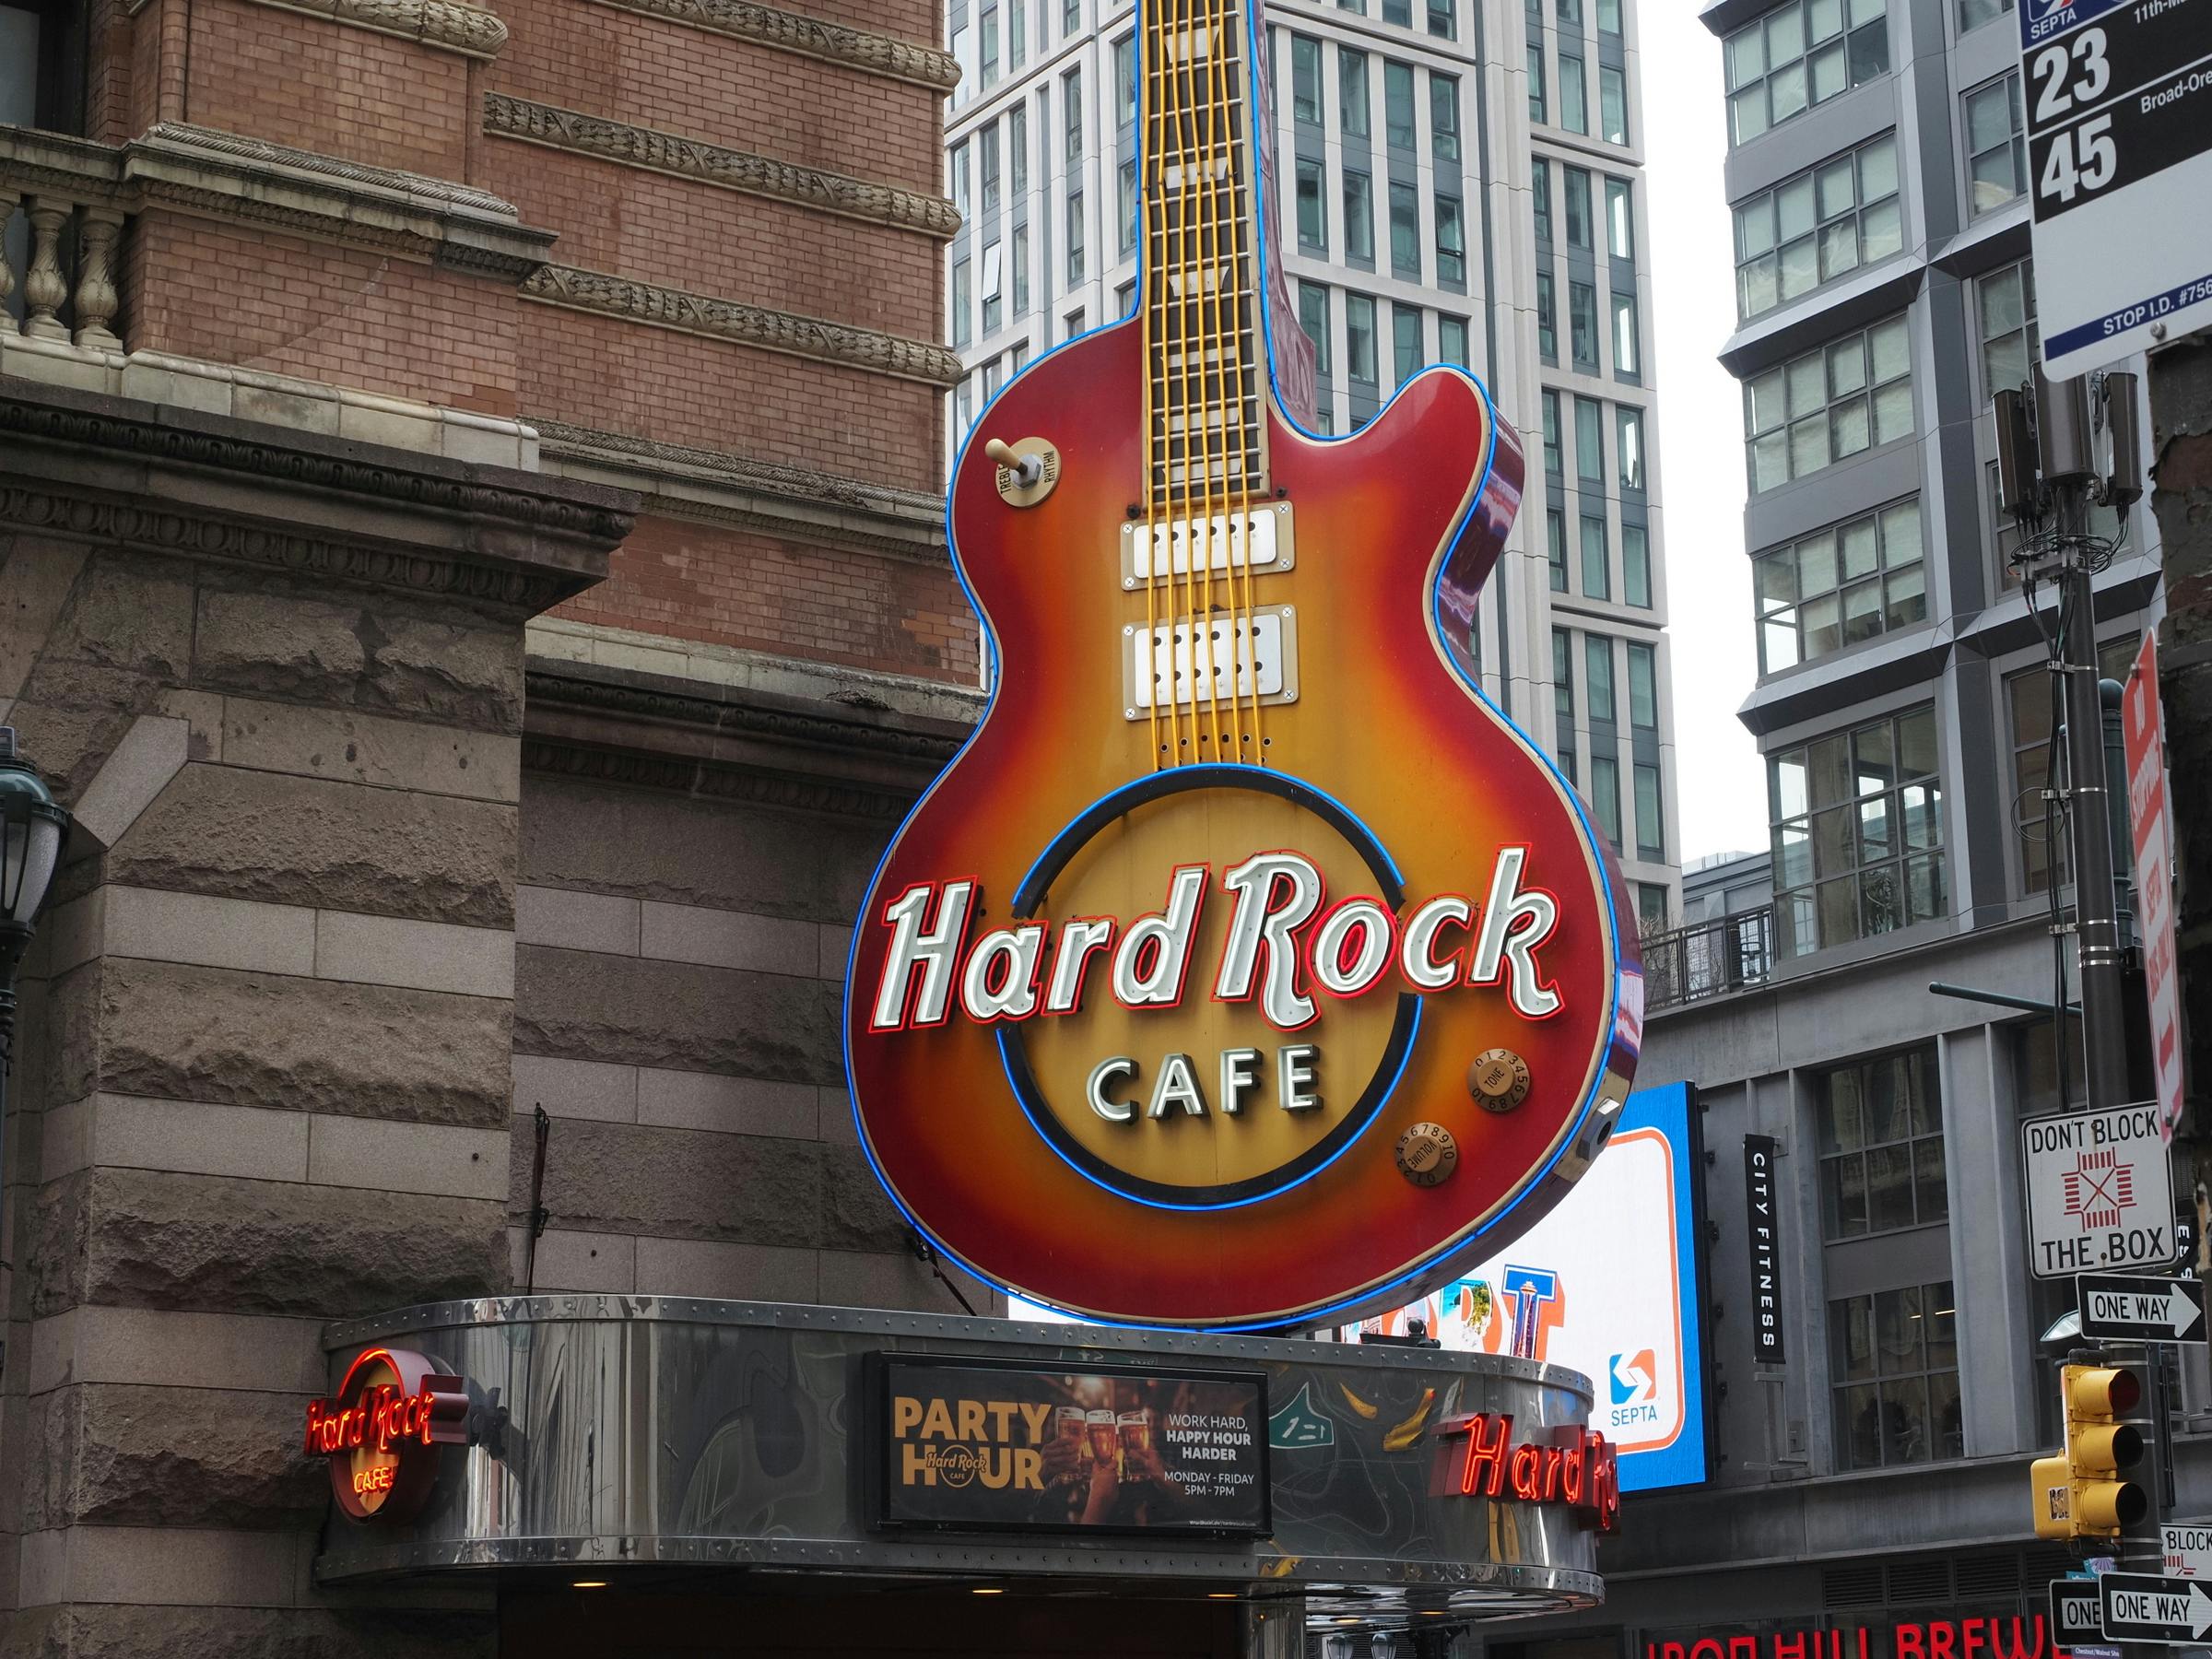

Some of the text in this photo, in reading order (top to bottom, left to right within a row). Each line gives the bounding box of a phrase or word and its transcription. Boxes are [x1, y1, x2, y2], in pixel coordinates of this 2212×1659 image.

[2030, 8, 2077, 40] SEPTA
[2134, 0, 2187, 24] 11th-M
[2032, 28, 2111, 123] 23
[2141, 70, 2212, 114] Broad-Ore
[2041, 112, 2117, 202] 45
[2103, 305, 2145, 335] STOP
[2149, 296, 2175, 321] I.D.
[868, 841, 1566, 1033] Hard Rock
[1476, 1058, 1484, 1067] 0
[1498, 1051, 1506, 1060] 2
[1509, 1055, 1518, 1065] 3
[1086, 1044, 1324, 1124] CAFE
[1484, 1067, 1505, 1088] TONE
[1400, 1135, 1409, 1144] 5
[1410, 1126, 1418, 1136] 6
[1422, 1124, 1429, 1134] 7
[1431, 1126, 1440, 1136] 8
[1439, 1134, 1449, 1143] 9
[2031, 1110, 2159, 1154] DON'T BLOCK
[1407, 1140, 1438, 1168] VOLUME
[1441, 1145, 1454, 1159] 10
[1753, 1152, 1775, 1347] CITY FITNESS
[2041, 1227, 2166, 1270] THE BOX
[2095, 1295, 2170, 1321] ONE WAY
[304, 1383, 435, 1453] Hard Rock
[893, 1396, 1052, 1444] PARTY
[1169, 1414, 1248, 1432] WORK HARD,
[1611, 1405, 1658, 1427] SEPTA
[1166, 1430, 1252, 1446] HAPPY HOUR
[926, 1453, 988, 1473] Hard Rock
[1182, 1446, 1237, 1461] HARDER
[1462, 1413, 1586, 1504] Hard
[353, 1466, 394, 1493] CAFE
[1164, 1471, 1211, 1483] MONDAY
[1218, 1473, 1254, 1485] FRIDAY
[1185, 1485, 1206, 1496] 5PM
[1214, 1486, 1235, 1497] 7PM
[2168, 1531, 2212, 1551] BLOCK
[2067, 1601, 2100, 1625] ONE
[2116, 1594, 2190, 1621] ONE WAY
[1897, 1615, 2072, 1659] BREW
